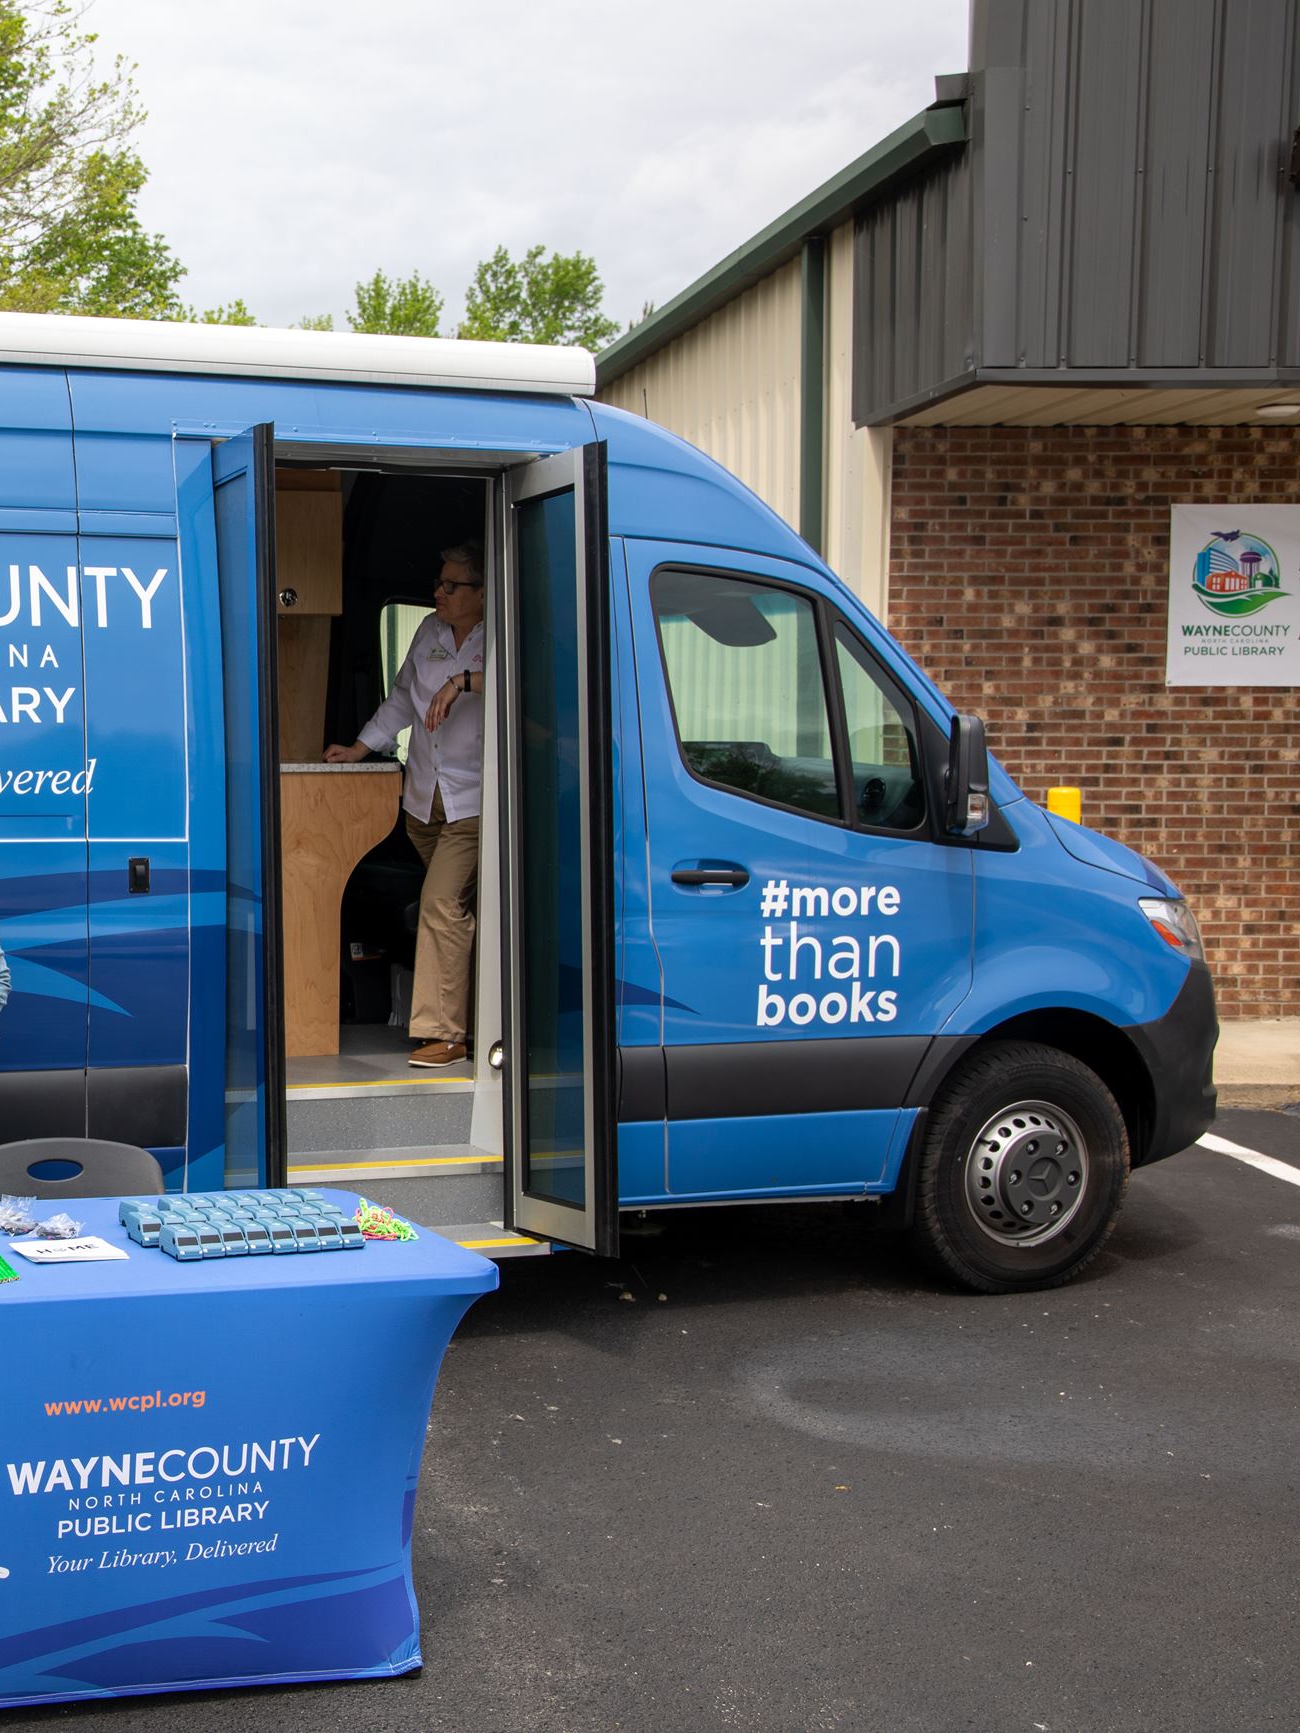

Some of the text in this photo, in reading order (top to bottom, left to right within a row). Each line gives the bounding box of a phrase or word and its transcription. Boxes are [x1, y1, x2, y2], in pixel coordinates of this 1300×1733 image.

[1184, 646, 1285, 656] PUBLIC LIBRARY
[760, 879, 901, 918] #more
[759, 920, 901, 982] than
[756, 981, 898, 1027] books
[44, 1389, 207, 1417] www.wcpl.org
[68, 1481, 264, 1511] NORTH CAROLINA
[57, 1500, 270, 1539] PUBLIC LIBRARY
[46, 1533, 279, 1575] Your Library, Delivered
